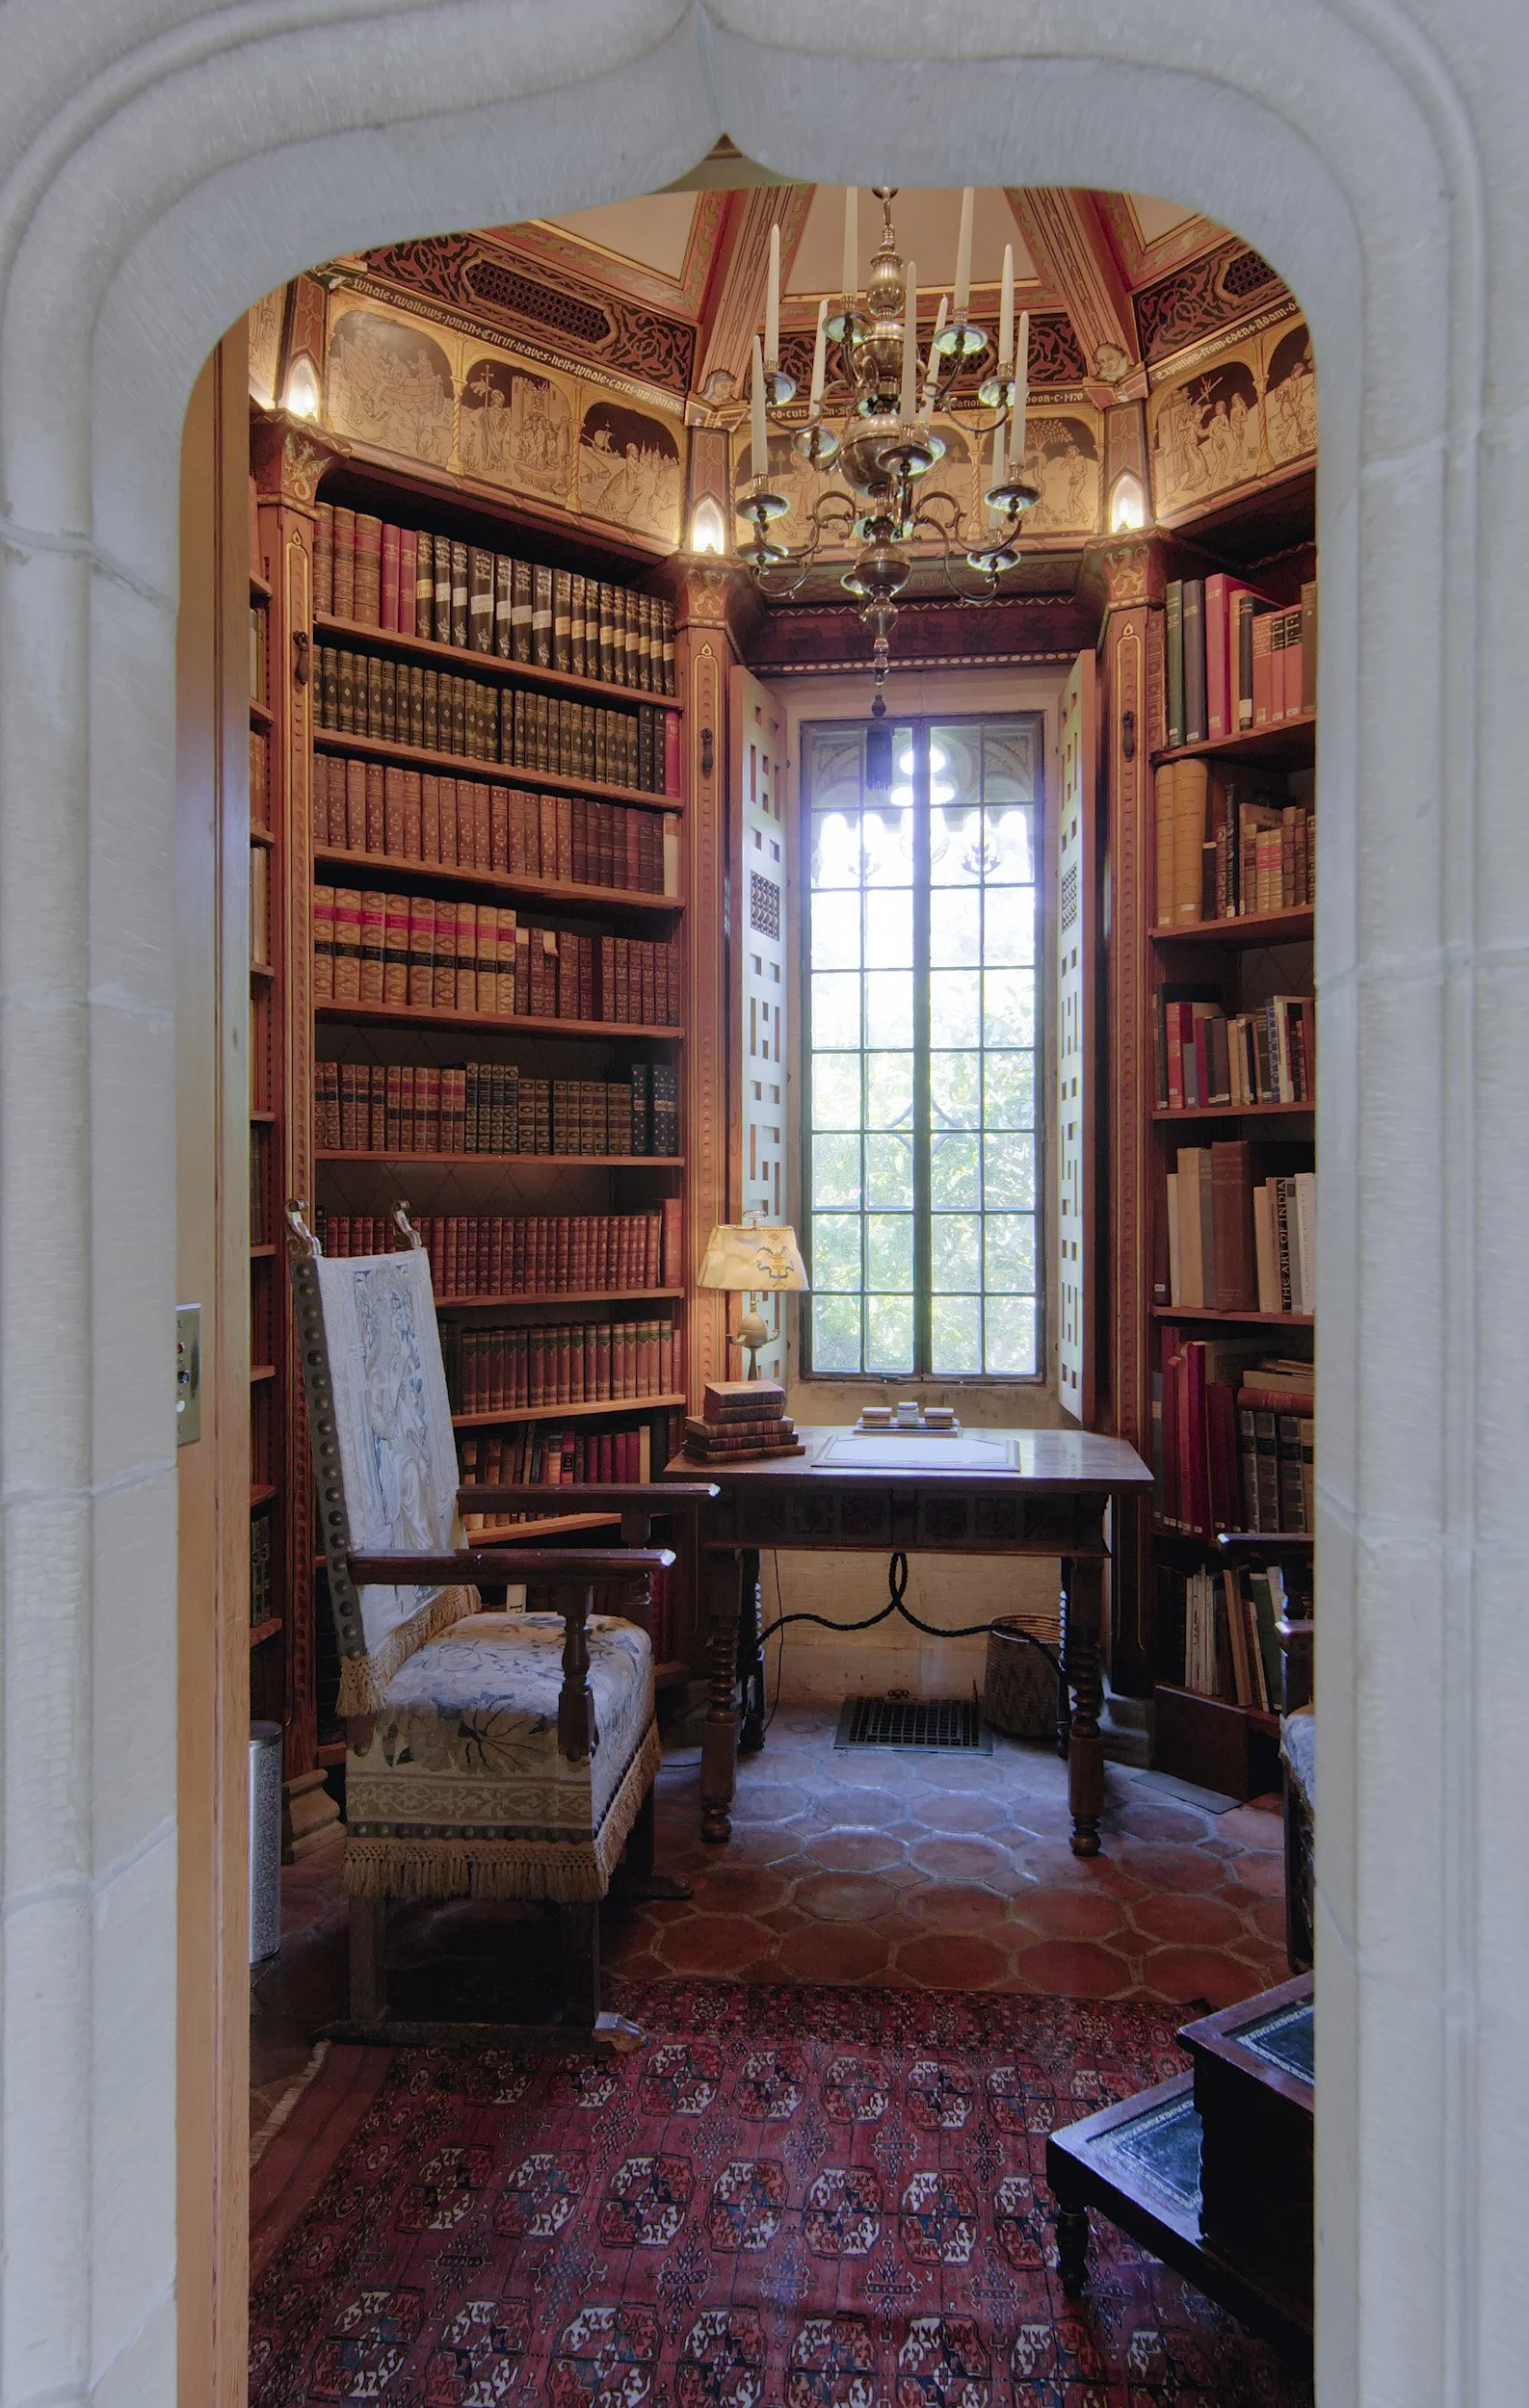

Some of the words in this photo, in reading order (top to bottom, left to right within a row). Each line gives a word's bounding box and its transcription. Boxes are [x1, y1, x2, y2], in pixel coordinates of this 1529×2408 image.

[393, 294, 442, 320] swallows
[514, 342, 548, 362] leaves
[636, 388, 650, 400] up
[1201, 332, 1225, 357] from
[1225, 329, 1251, 345] eden
[1255, 310, 1287, 330] Adam
[1277, 1180, 1288, 1221] INDIA
[1278, 1225, 1288, 1244] OF
[1279, 1248, 1290, 1276] ART
[1282, 1276, 1291, 1304] THE
